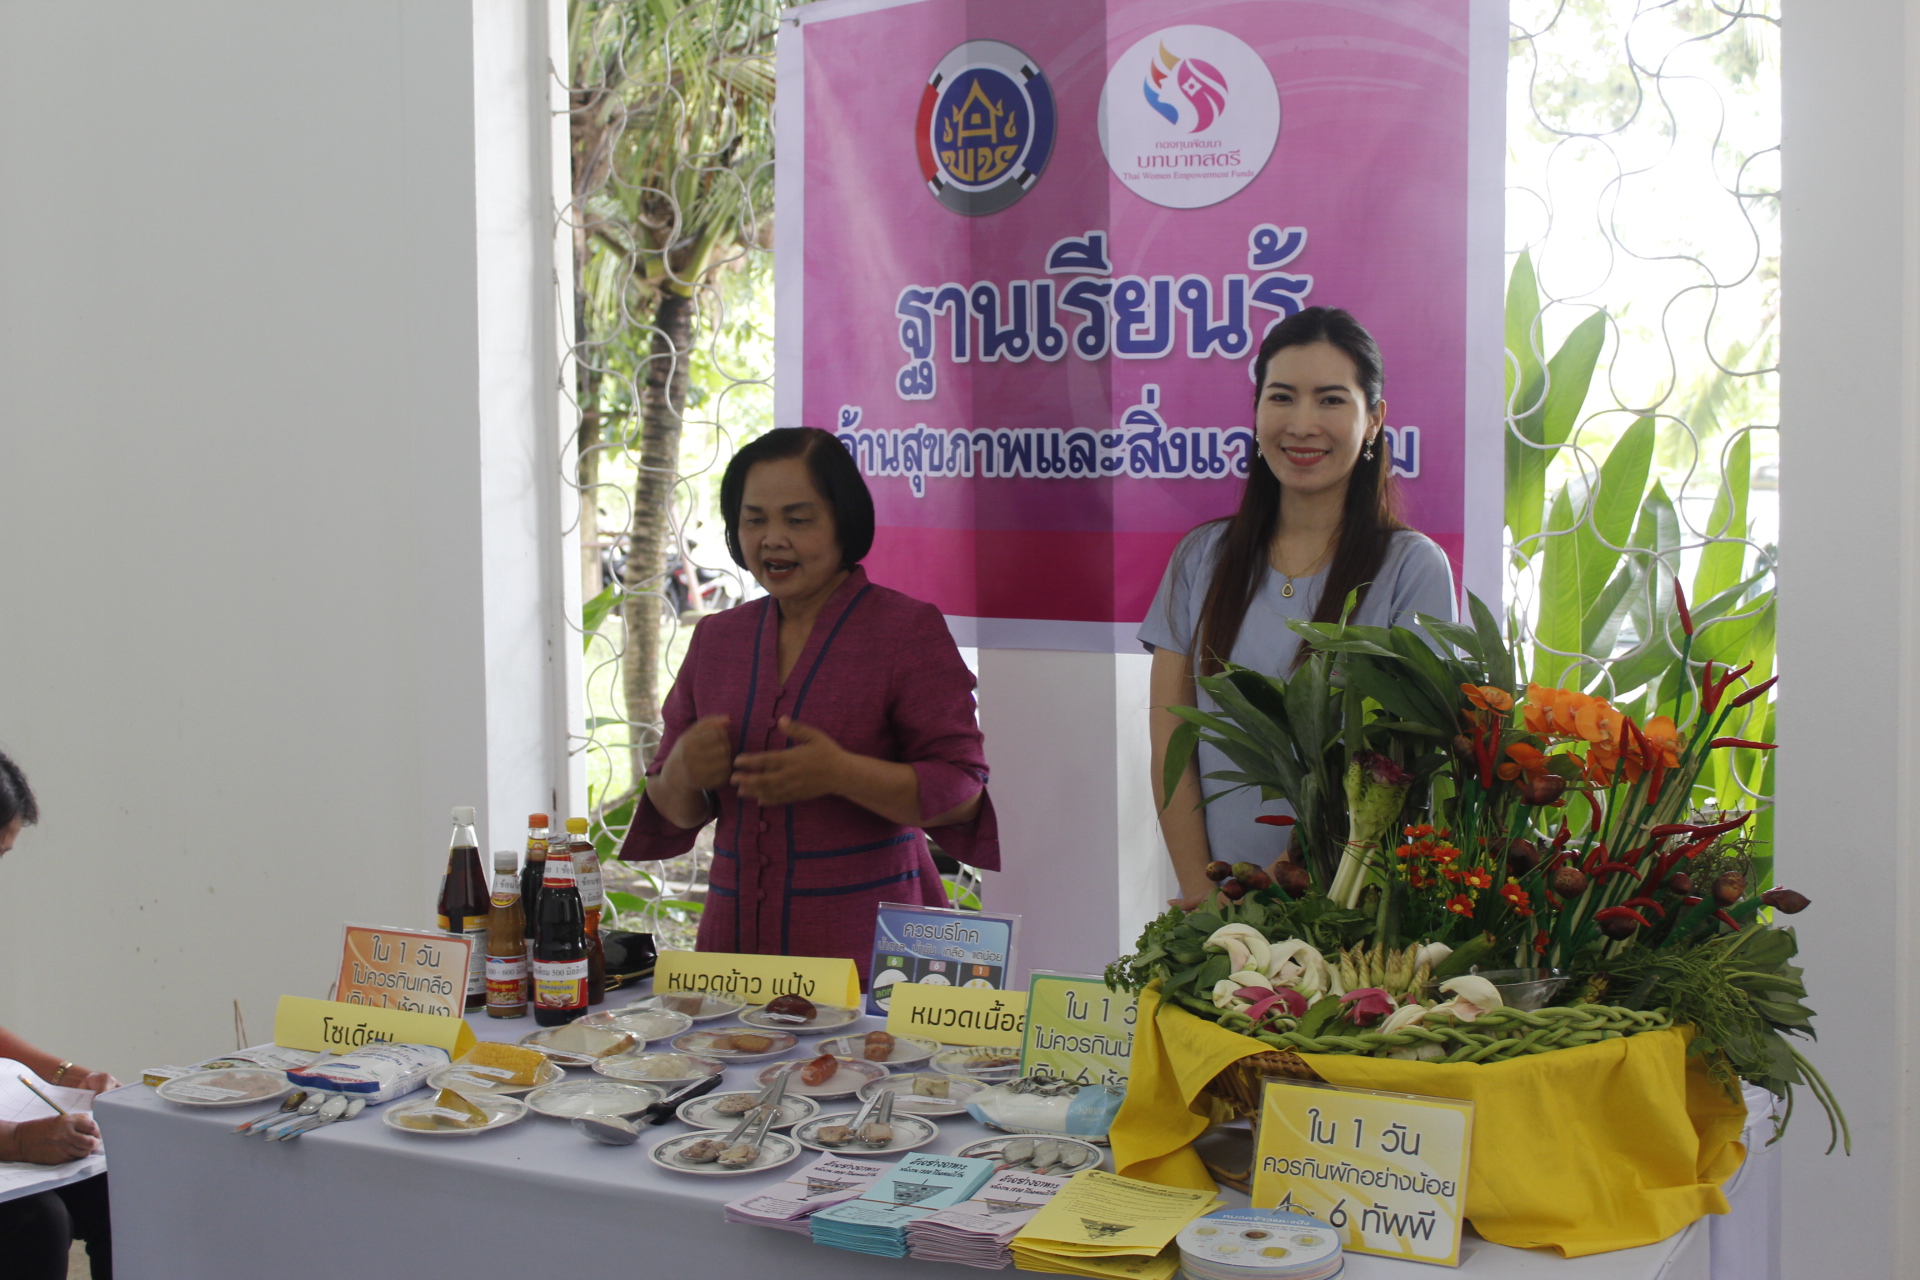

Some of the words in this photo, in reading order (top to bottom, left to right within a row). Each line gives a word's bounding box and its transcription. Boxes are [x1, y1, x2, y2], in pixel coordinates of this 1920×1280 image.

[1155, 139, 1222, 150] กองทุนพัฒนา
[1137, 149, 1241, 168] บทบาทสตรี
[1123, 172, 1140, 180] Thai
[1142, 171, 1171, 180] Women
[1173, 170, 1229, 182] Empowerment
[1231, 169, 1255, 179] Funds
[897, 227, 1310, 396] ฐานเรียนร้
[904, 921, 979, 943] ควรบริโภค
[372, 935, 390, 962] ใน
[400, 942, 406, 964] 1
[416, 944, 441, 968] วัน
[877, 936, 906, 952] น้ำตาล
[912, 940, 936, 955] น้ำมัน
[942, 946, 965, 958] เกลือ
[972, 949, 1003, 962] แต่น้อย
[891, 957, 898, 966] 6
[552, 968, 564, 977] 500
[934, 962, 940, 970] 6
[978, 966, 984, 975] 1
[353, 963, 453, 996] ไม่ควรกินเกลือ
[668, 968, 762, 994] หมวดข้าว
[772, 972, 816, 997] แป้ง
[1065, 991, 1088, 1020] ใน
[1102, 998, 1109, 1022] 1
[1308, 1108, 1336, 1145] ใน
[1353, 1119, 1363, 1148] 1
[1381, 1123, 1421, 1156] วัน
[1263, 1156, 1456, 1197] ควรกินผักอย่างน้อย
[1329, 1198, 1348, 1228] 6
[1361, 1203, 1436, 1241] ทัพพี
